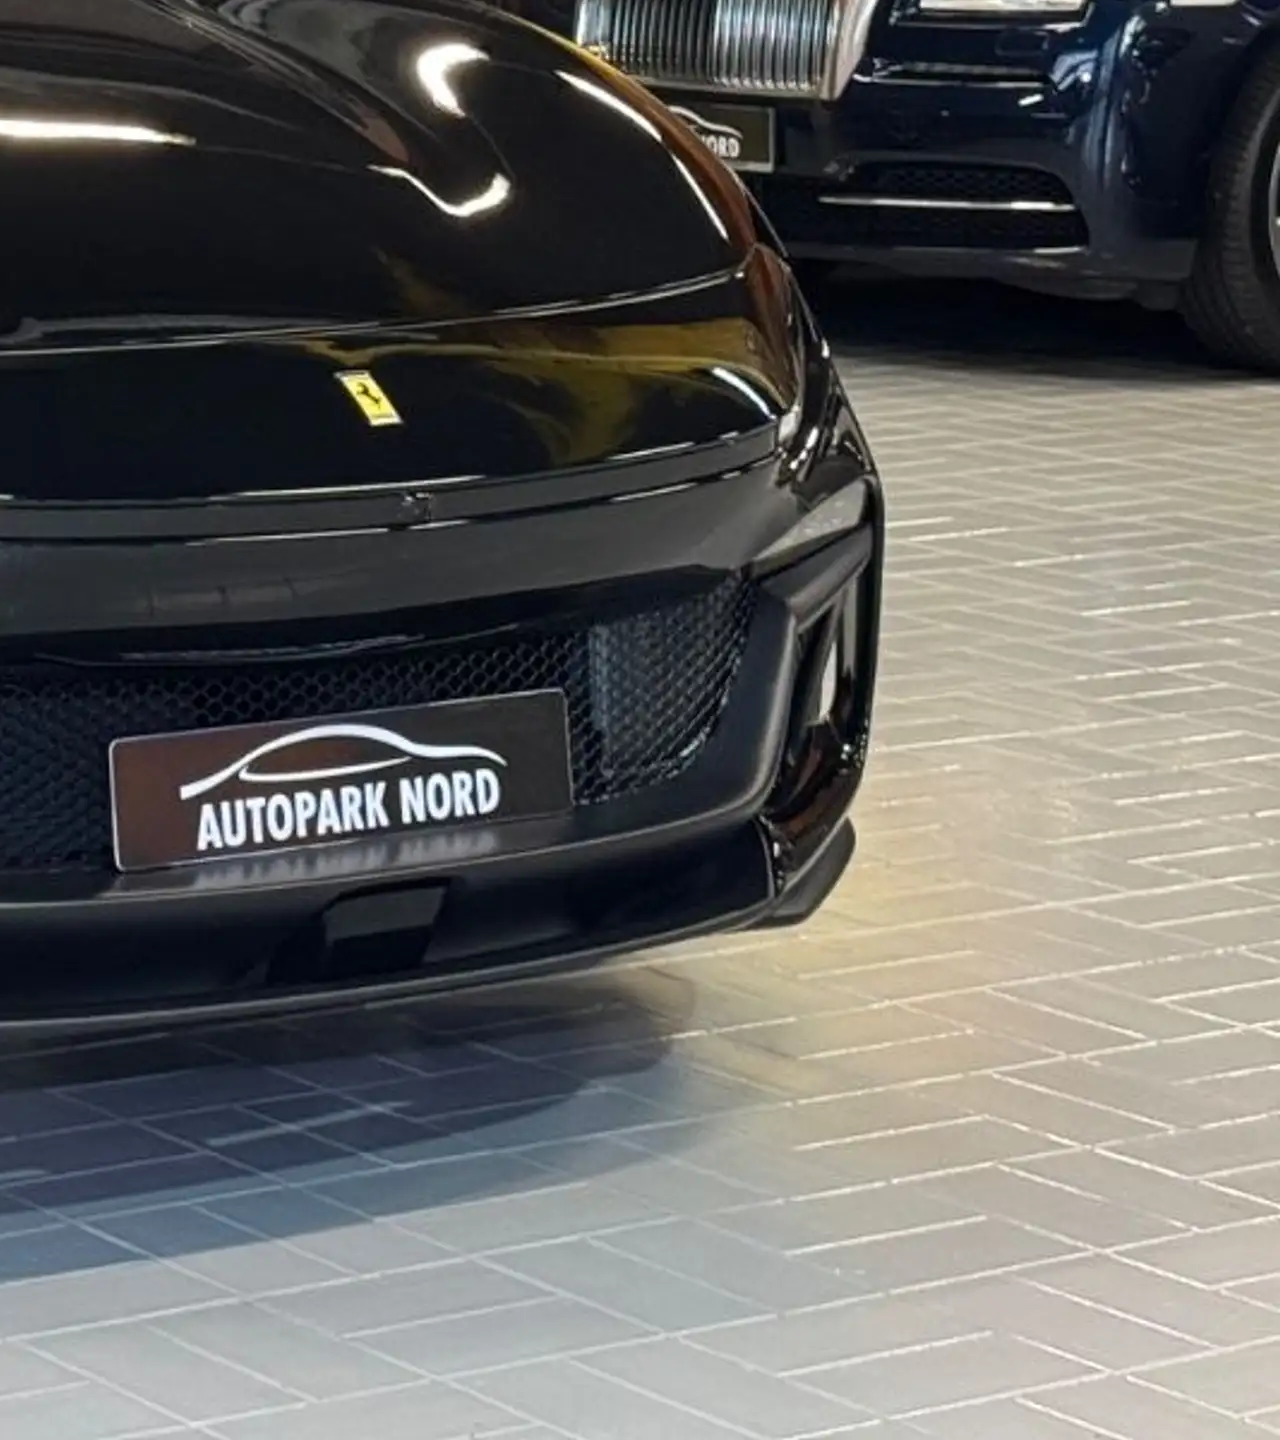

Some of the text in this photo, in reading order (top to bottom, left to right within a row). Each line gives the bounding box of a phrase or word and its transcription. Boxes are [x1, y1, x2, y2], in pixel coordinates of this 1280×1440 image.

[700, 134, 740, 159] ORD
[196, 767, 501, 852] AUTOPARK NORD
